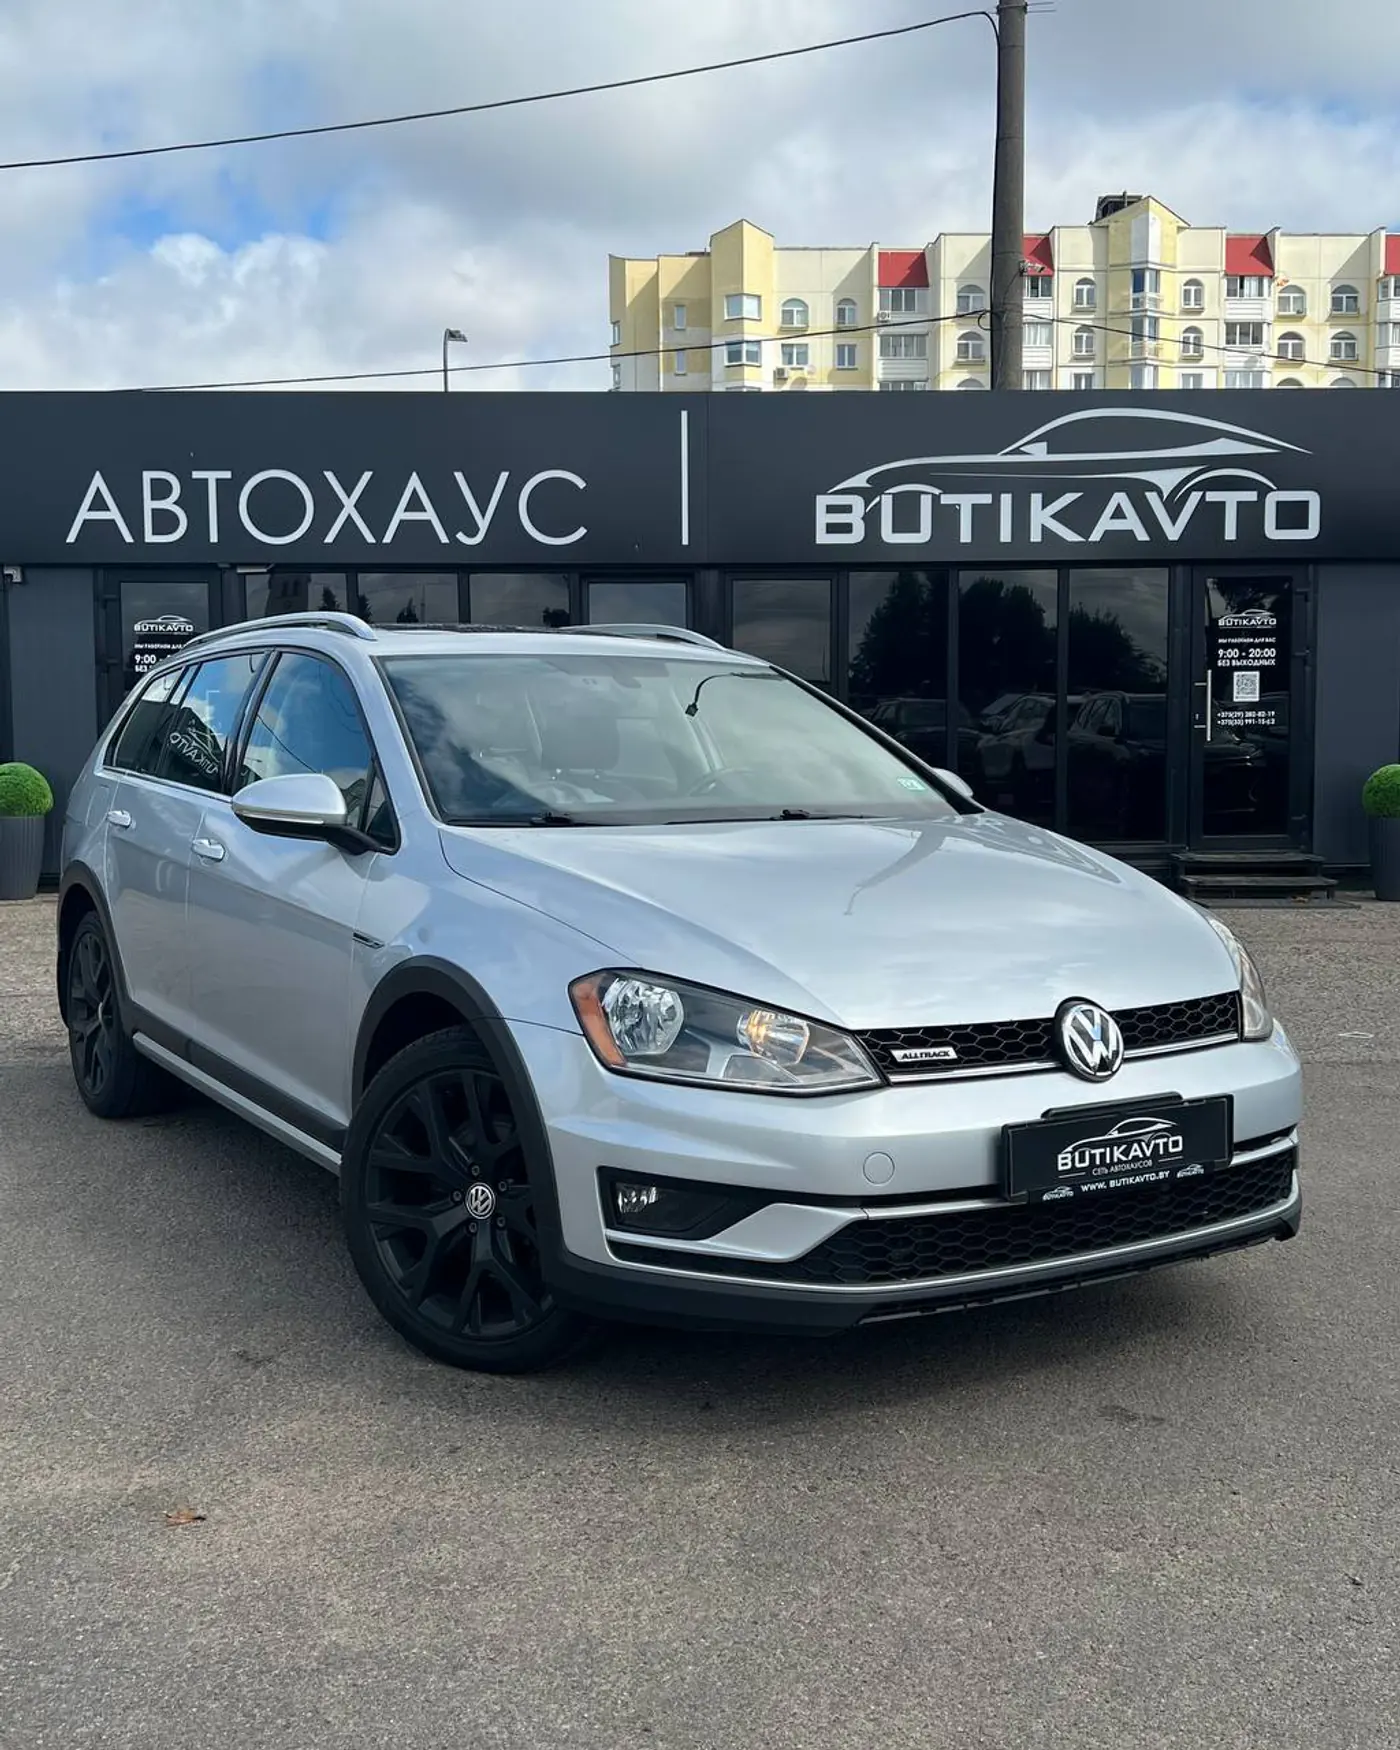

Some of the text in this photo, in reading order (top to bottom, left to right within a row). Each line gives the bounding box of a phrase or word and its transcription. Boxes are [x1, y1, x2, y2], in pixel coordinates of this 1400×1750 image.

[66, 468, 588, 546] АВТОХАУС
[815, 489, 1321, 545] BUTIKAVTO
[1218, 618, 1277, 626] BUTIKAVTO
[134, 623, 194, 632] BUTIKAVTO
[1218, 648, 1239, 658] 9:00
[1248, 648, 1276, 658] 20:00
[135, 654, 157, 664] 9:00
[901, 1050, 950, 1060] ALLTRACK
[1057, 1135, 1183, 1171] BUTIKAVTO
